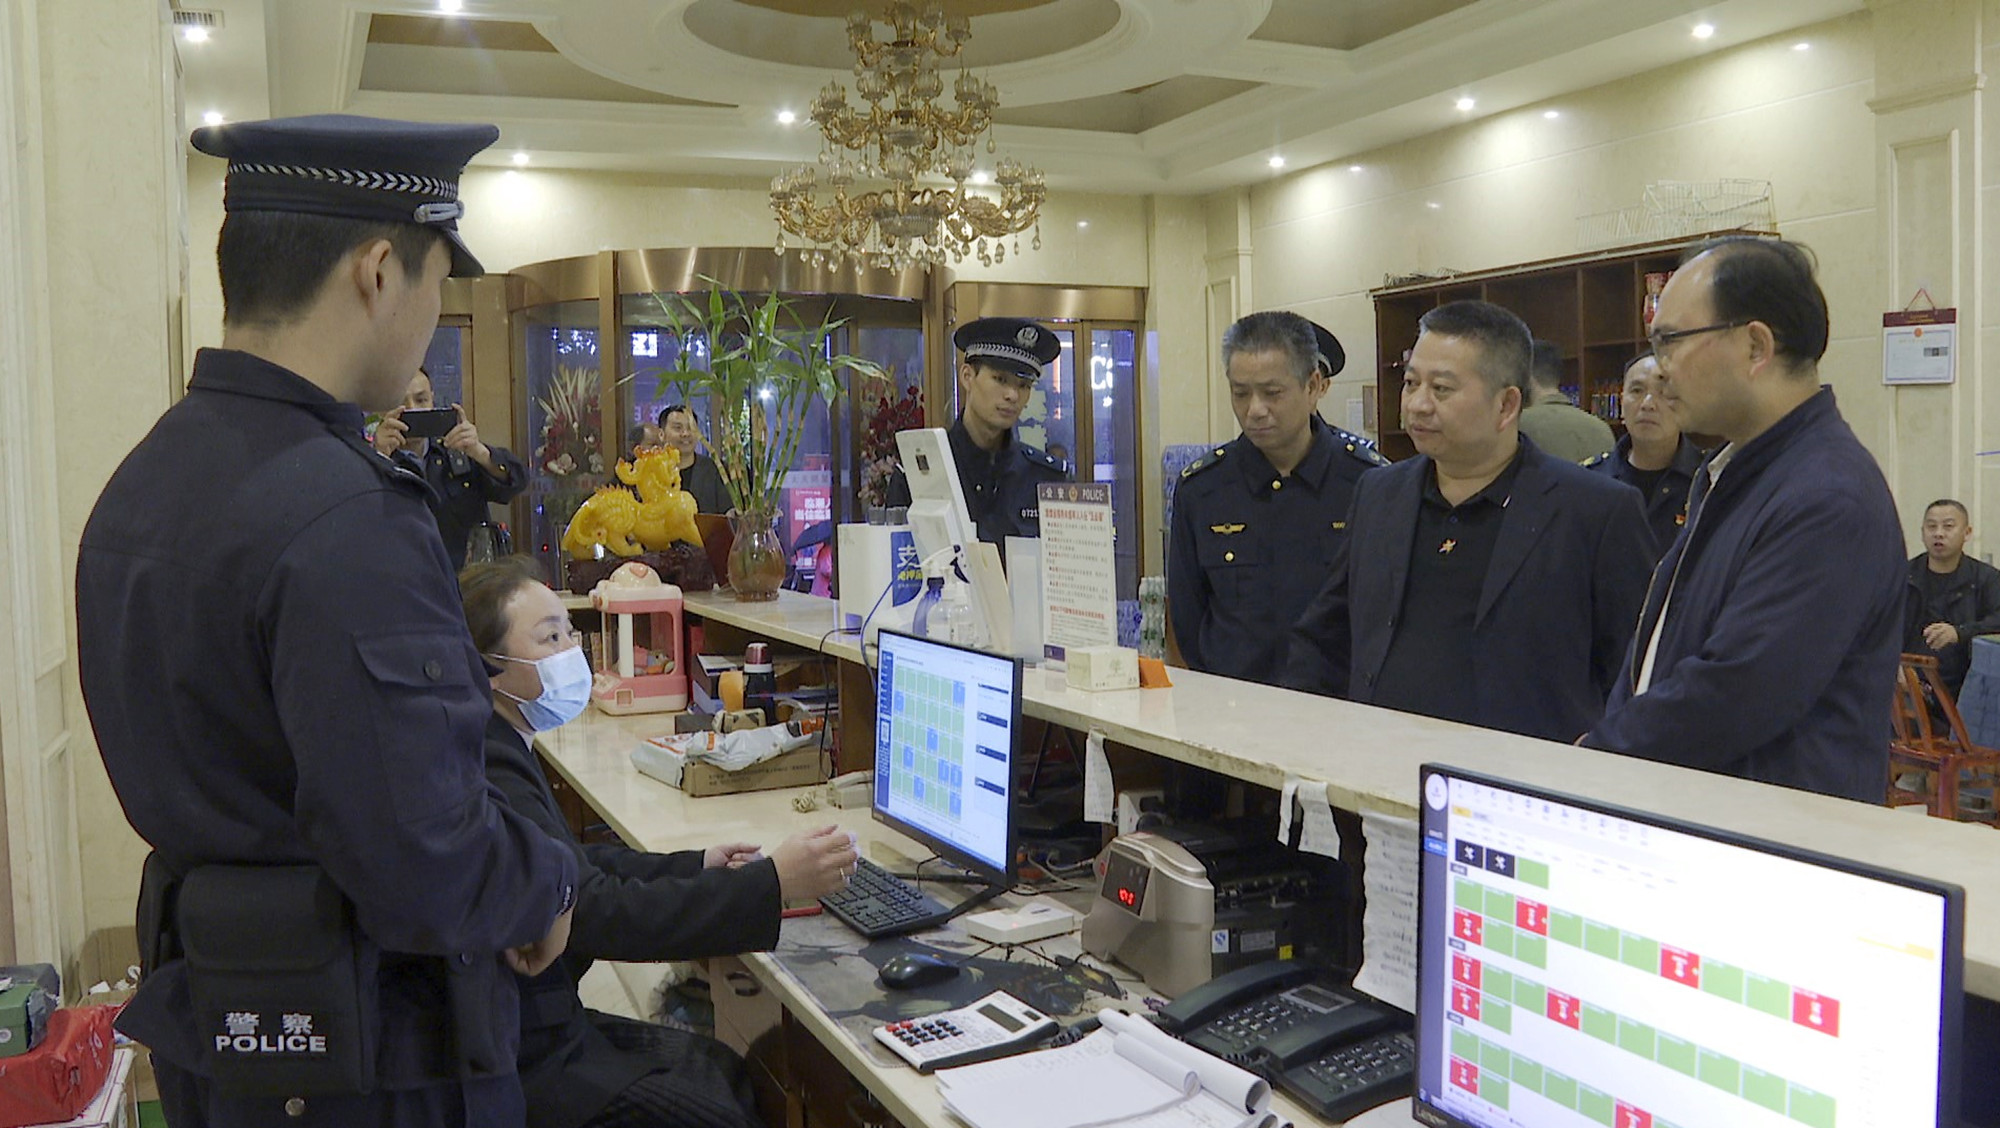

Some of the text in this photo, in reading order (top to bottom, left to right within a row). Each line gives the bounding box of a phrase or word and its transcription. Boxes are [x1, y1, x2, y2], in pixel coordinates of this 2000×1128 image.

[1082, 488, 1104, 502] POLICE
[225, 1012, 314, 1035] 警察
[215, 1034, 328, 1053] POLICE
